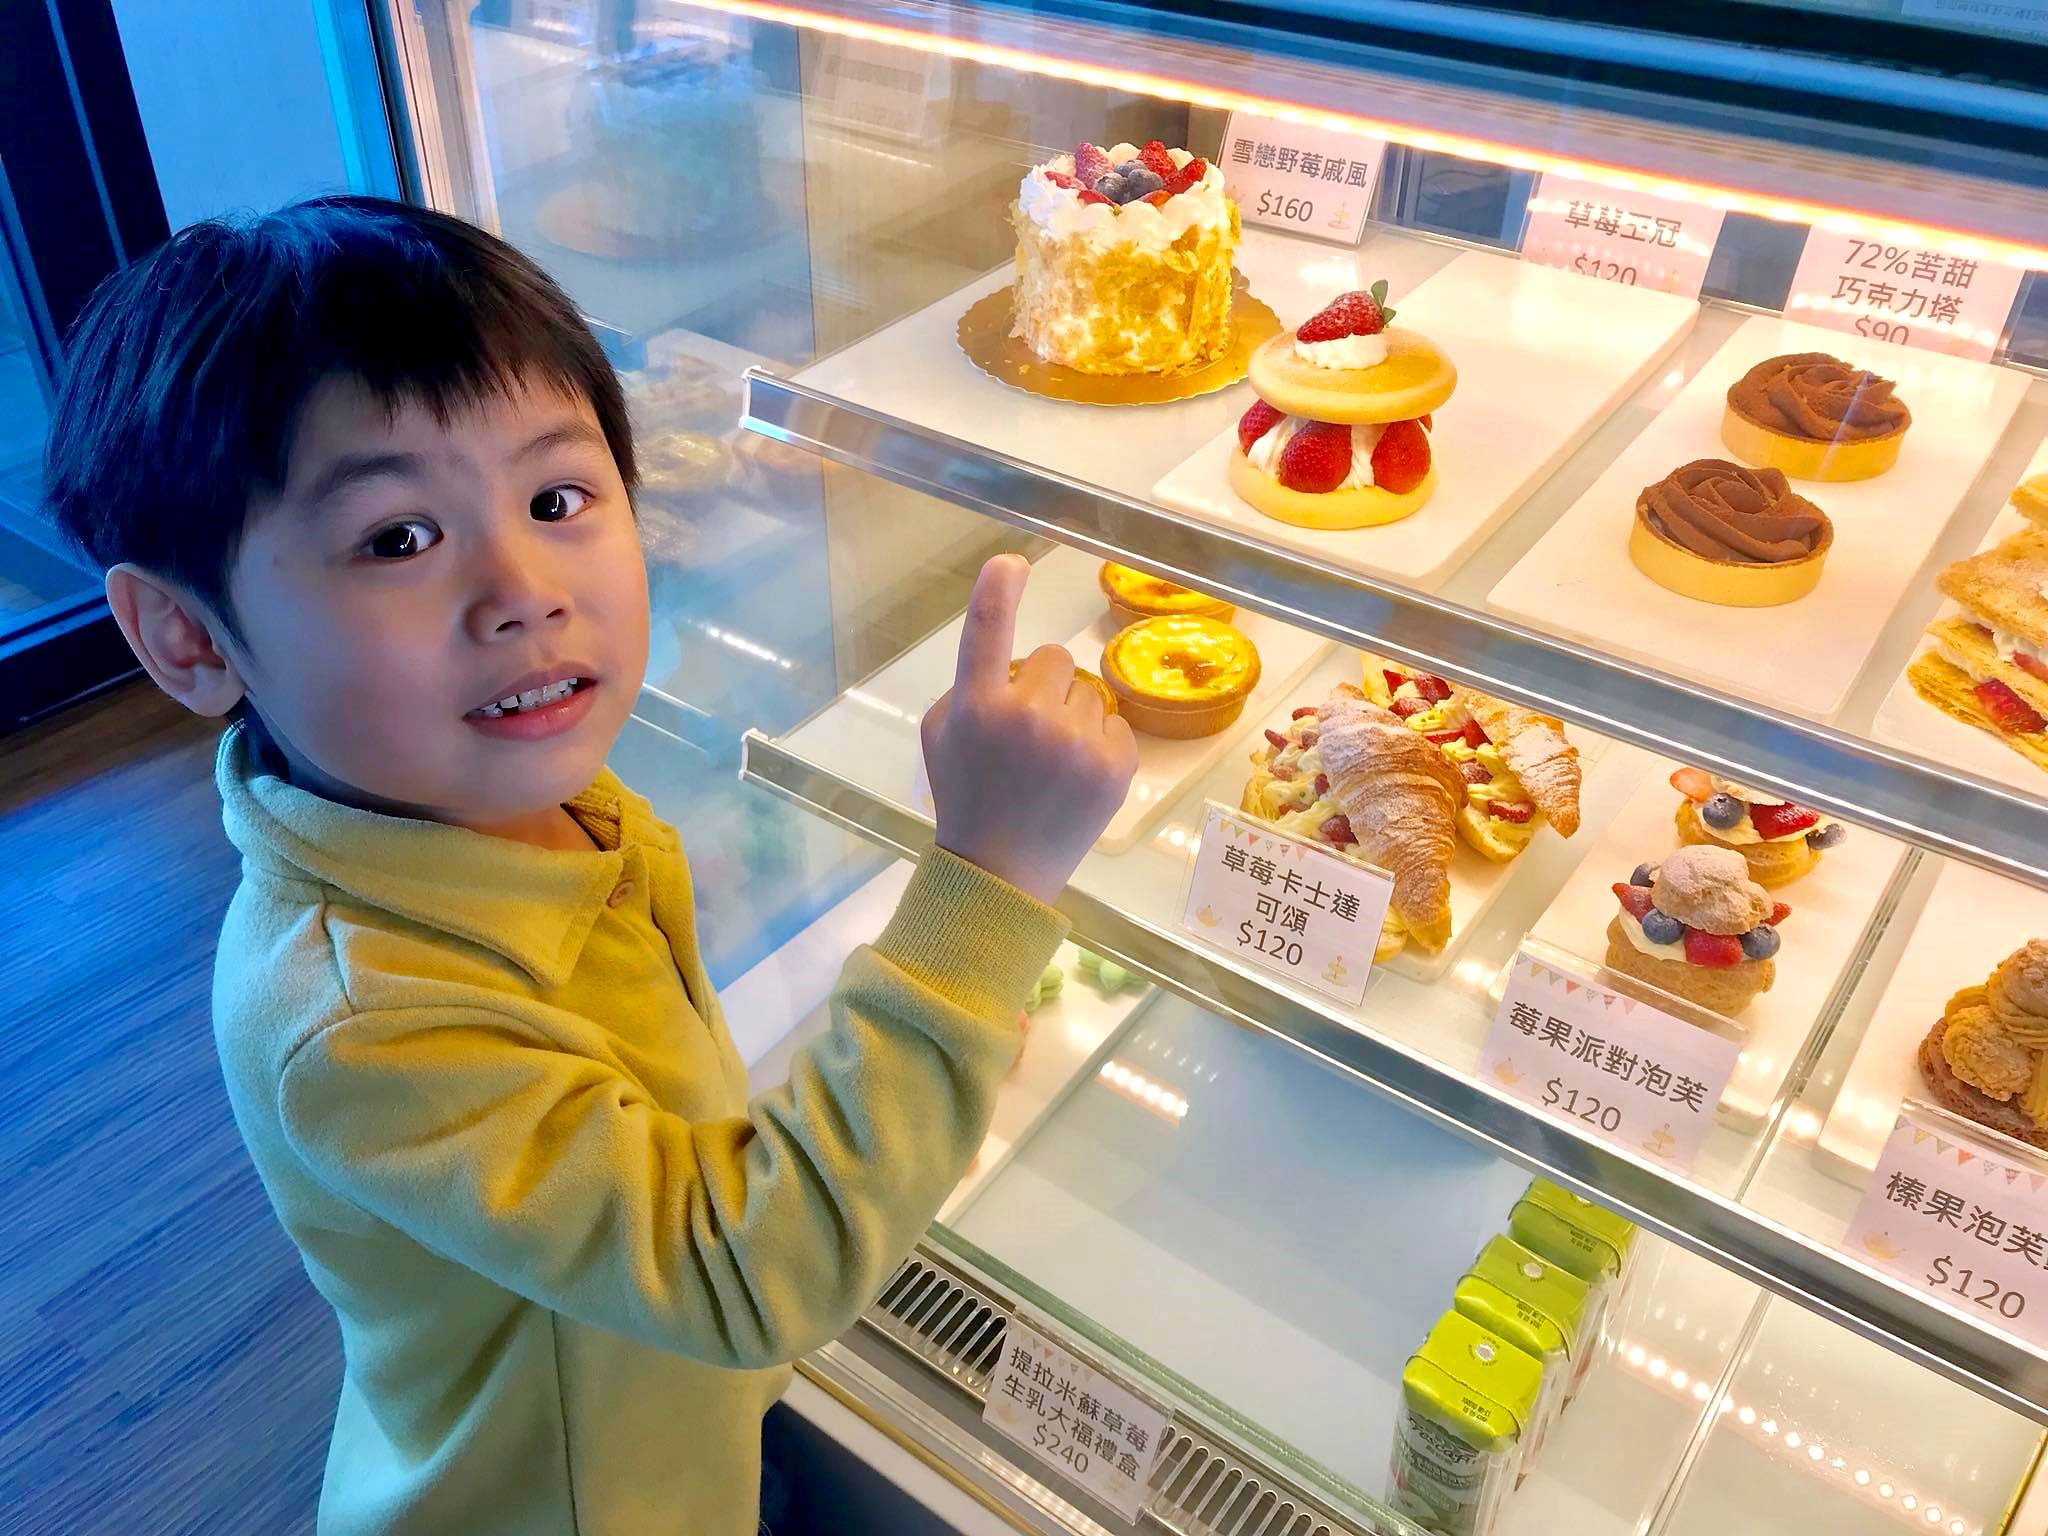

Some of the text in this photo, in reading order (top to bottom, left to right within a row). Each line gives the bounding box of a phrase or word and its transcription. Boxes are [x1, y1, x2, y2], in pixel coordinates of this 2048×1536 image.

[1231, 138, 1368, 189] 雪戀野莓戚風
[1256, 189, 1314, 222] $160
[1574, 253, 1638, 286] $120
[1842, 239, 1978, 289] 72%苦甜
[1831, 275, 1964, 326] 巧克力塔
[1854, 314, 1910, 346] $90
[1221, 843, 1361, 923] 草莓卡士達
[1255, 892, 1310, 937] 可頌
[1236, 919, 1304, 966] $120
[1508, 1001, 1709, 1113] 莓果派對泡芙
[1541, 1077, 1622, 1132] $120
[1885, 1170, 2048, 1271] 榛果泡芙
[1926, 1255, 2026, 1319] $120
[1009, 1346, 1150, 1453] 提拉米蘇草莓
[1001, 1374, 1141, 1482] 生乳大福禮盒
[1032, 1423, 1090, 1474] $240
